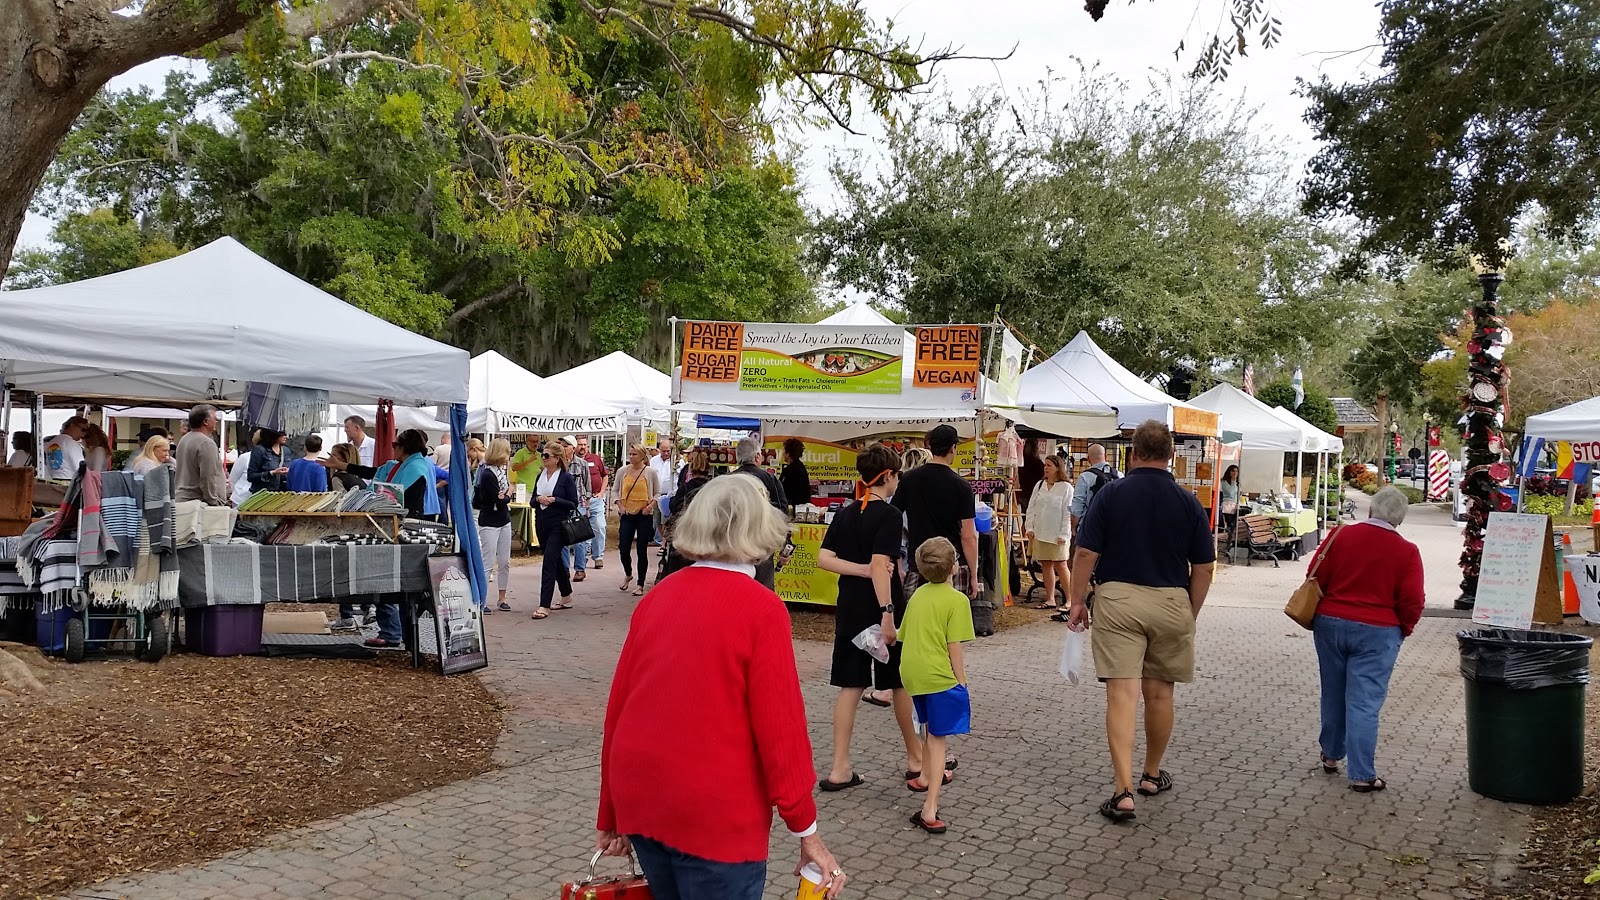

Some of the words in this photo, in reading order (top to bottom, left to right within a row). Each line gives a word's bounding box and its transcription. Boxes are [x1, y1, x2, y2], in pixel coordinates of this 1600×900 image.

[691, 323, 739, 337] DAIRY
[918, 329, 979, 343] GLUTEN
[690, 336, 738, 350] FREE
[745, 331, 780, 346] Spread
[782, 332, 796, 344] the
[798, 333, 818, 347] Joy
[820, 335, 830, 345] to
[832, 333, 860, 345] Your
[861, 332, 901, 346] Kitchen
[918, 343, 978, 361] FREE
[687, 353, 736, 367] SUGAR
[744, 357, 756, 366] All
[758, 358, 792, 366] Natural
[686, 366, 735, 379] FREE
[743, 368, 767, 376] ZERO
[917, 369, 976, 384] VEGAN
[501, 413, 583, 431] INFORMATION
[588, 416, 617, 430] TENT
[800, 449, 840, 463] atural
[792, 552, 815, 560] STEROL
[794, 568, 814, 576] DAIRY
[777, 578, 811, 589] GAN
[777, 591, 811, 600] ATURAL
